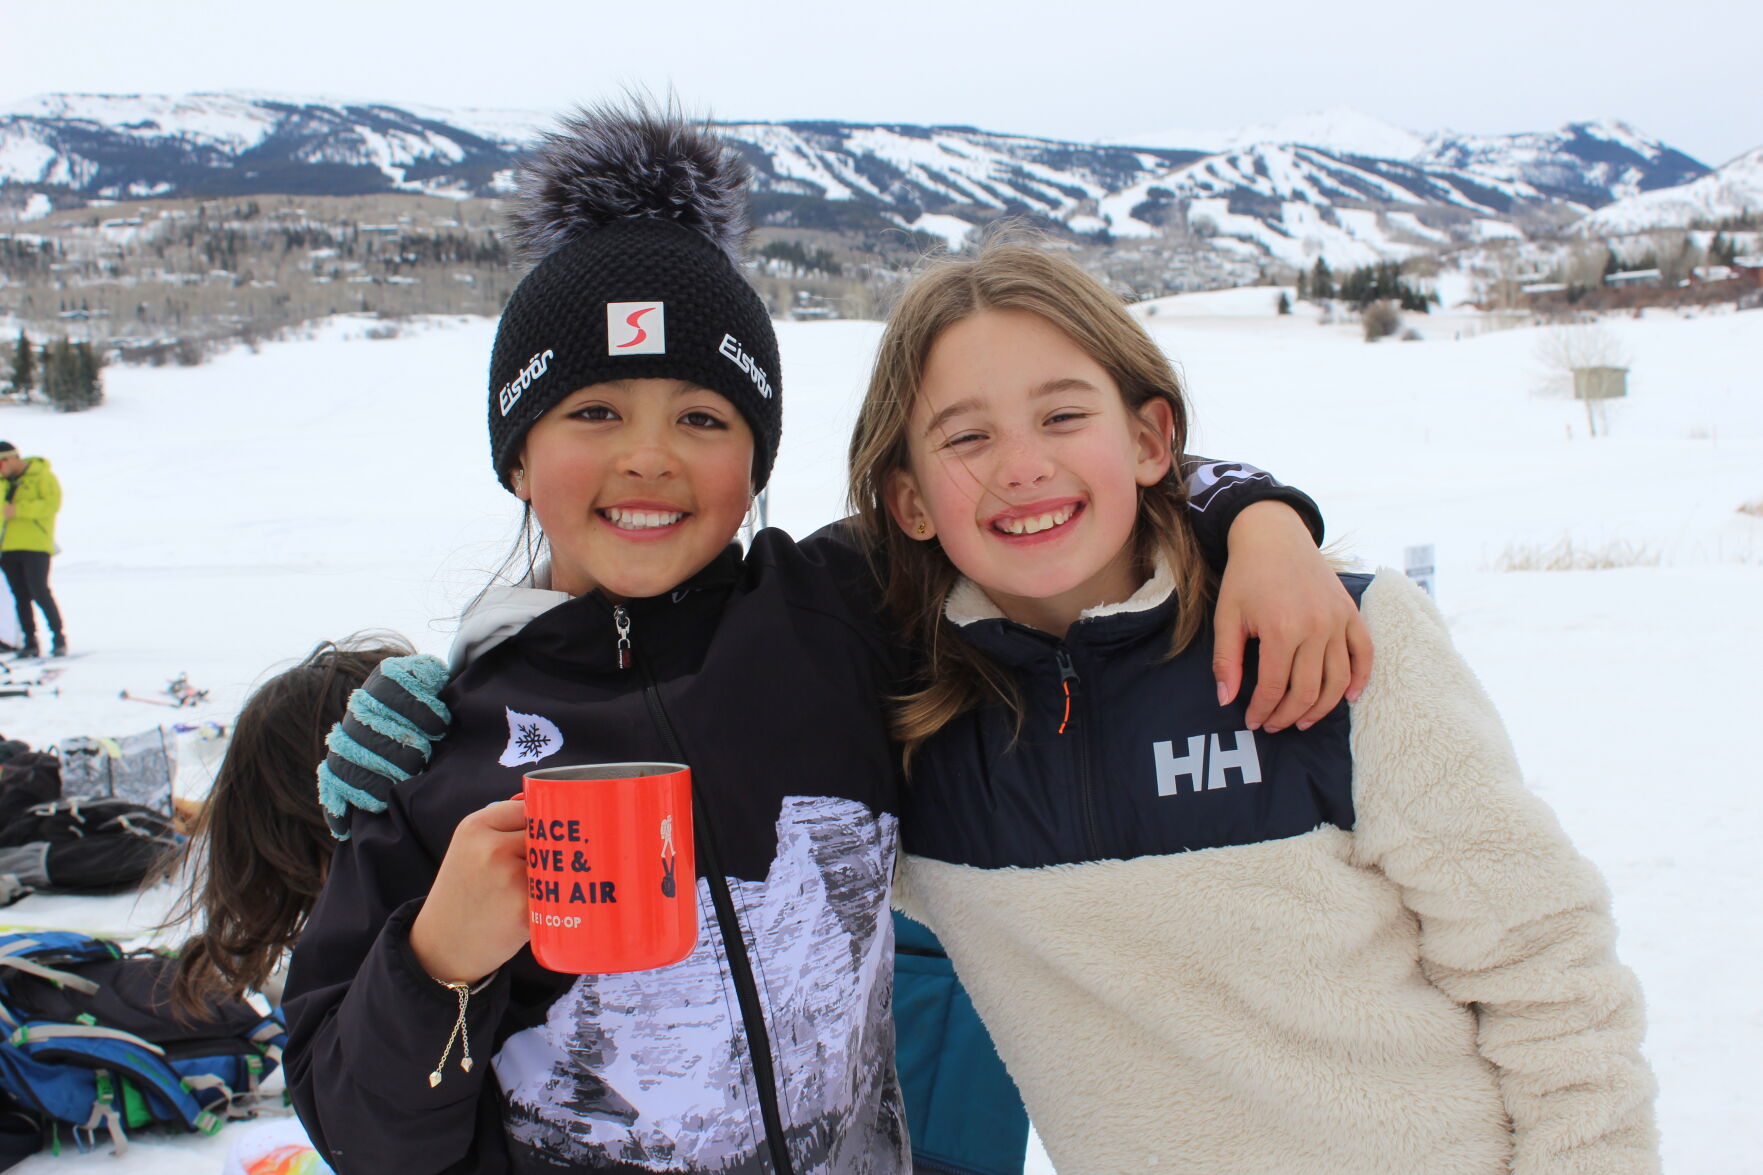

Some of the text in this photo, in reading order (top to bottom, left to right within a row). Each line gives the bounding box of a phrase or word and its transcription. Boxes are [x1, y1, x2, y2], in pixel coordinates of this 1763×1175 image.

[719, 333, 773, 399] Eisbär
[499, 349, 554, 417] Eisbär
[527, 818, 589, 844] EACE,
[528, 847, 592, 873] OVE &
[528, 877, 617, 904] ESH AIR
